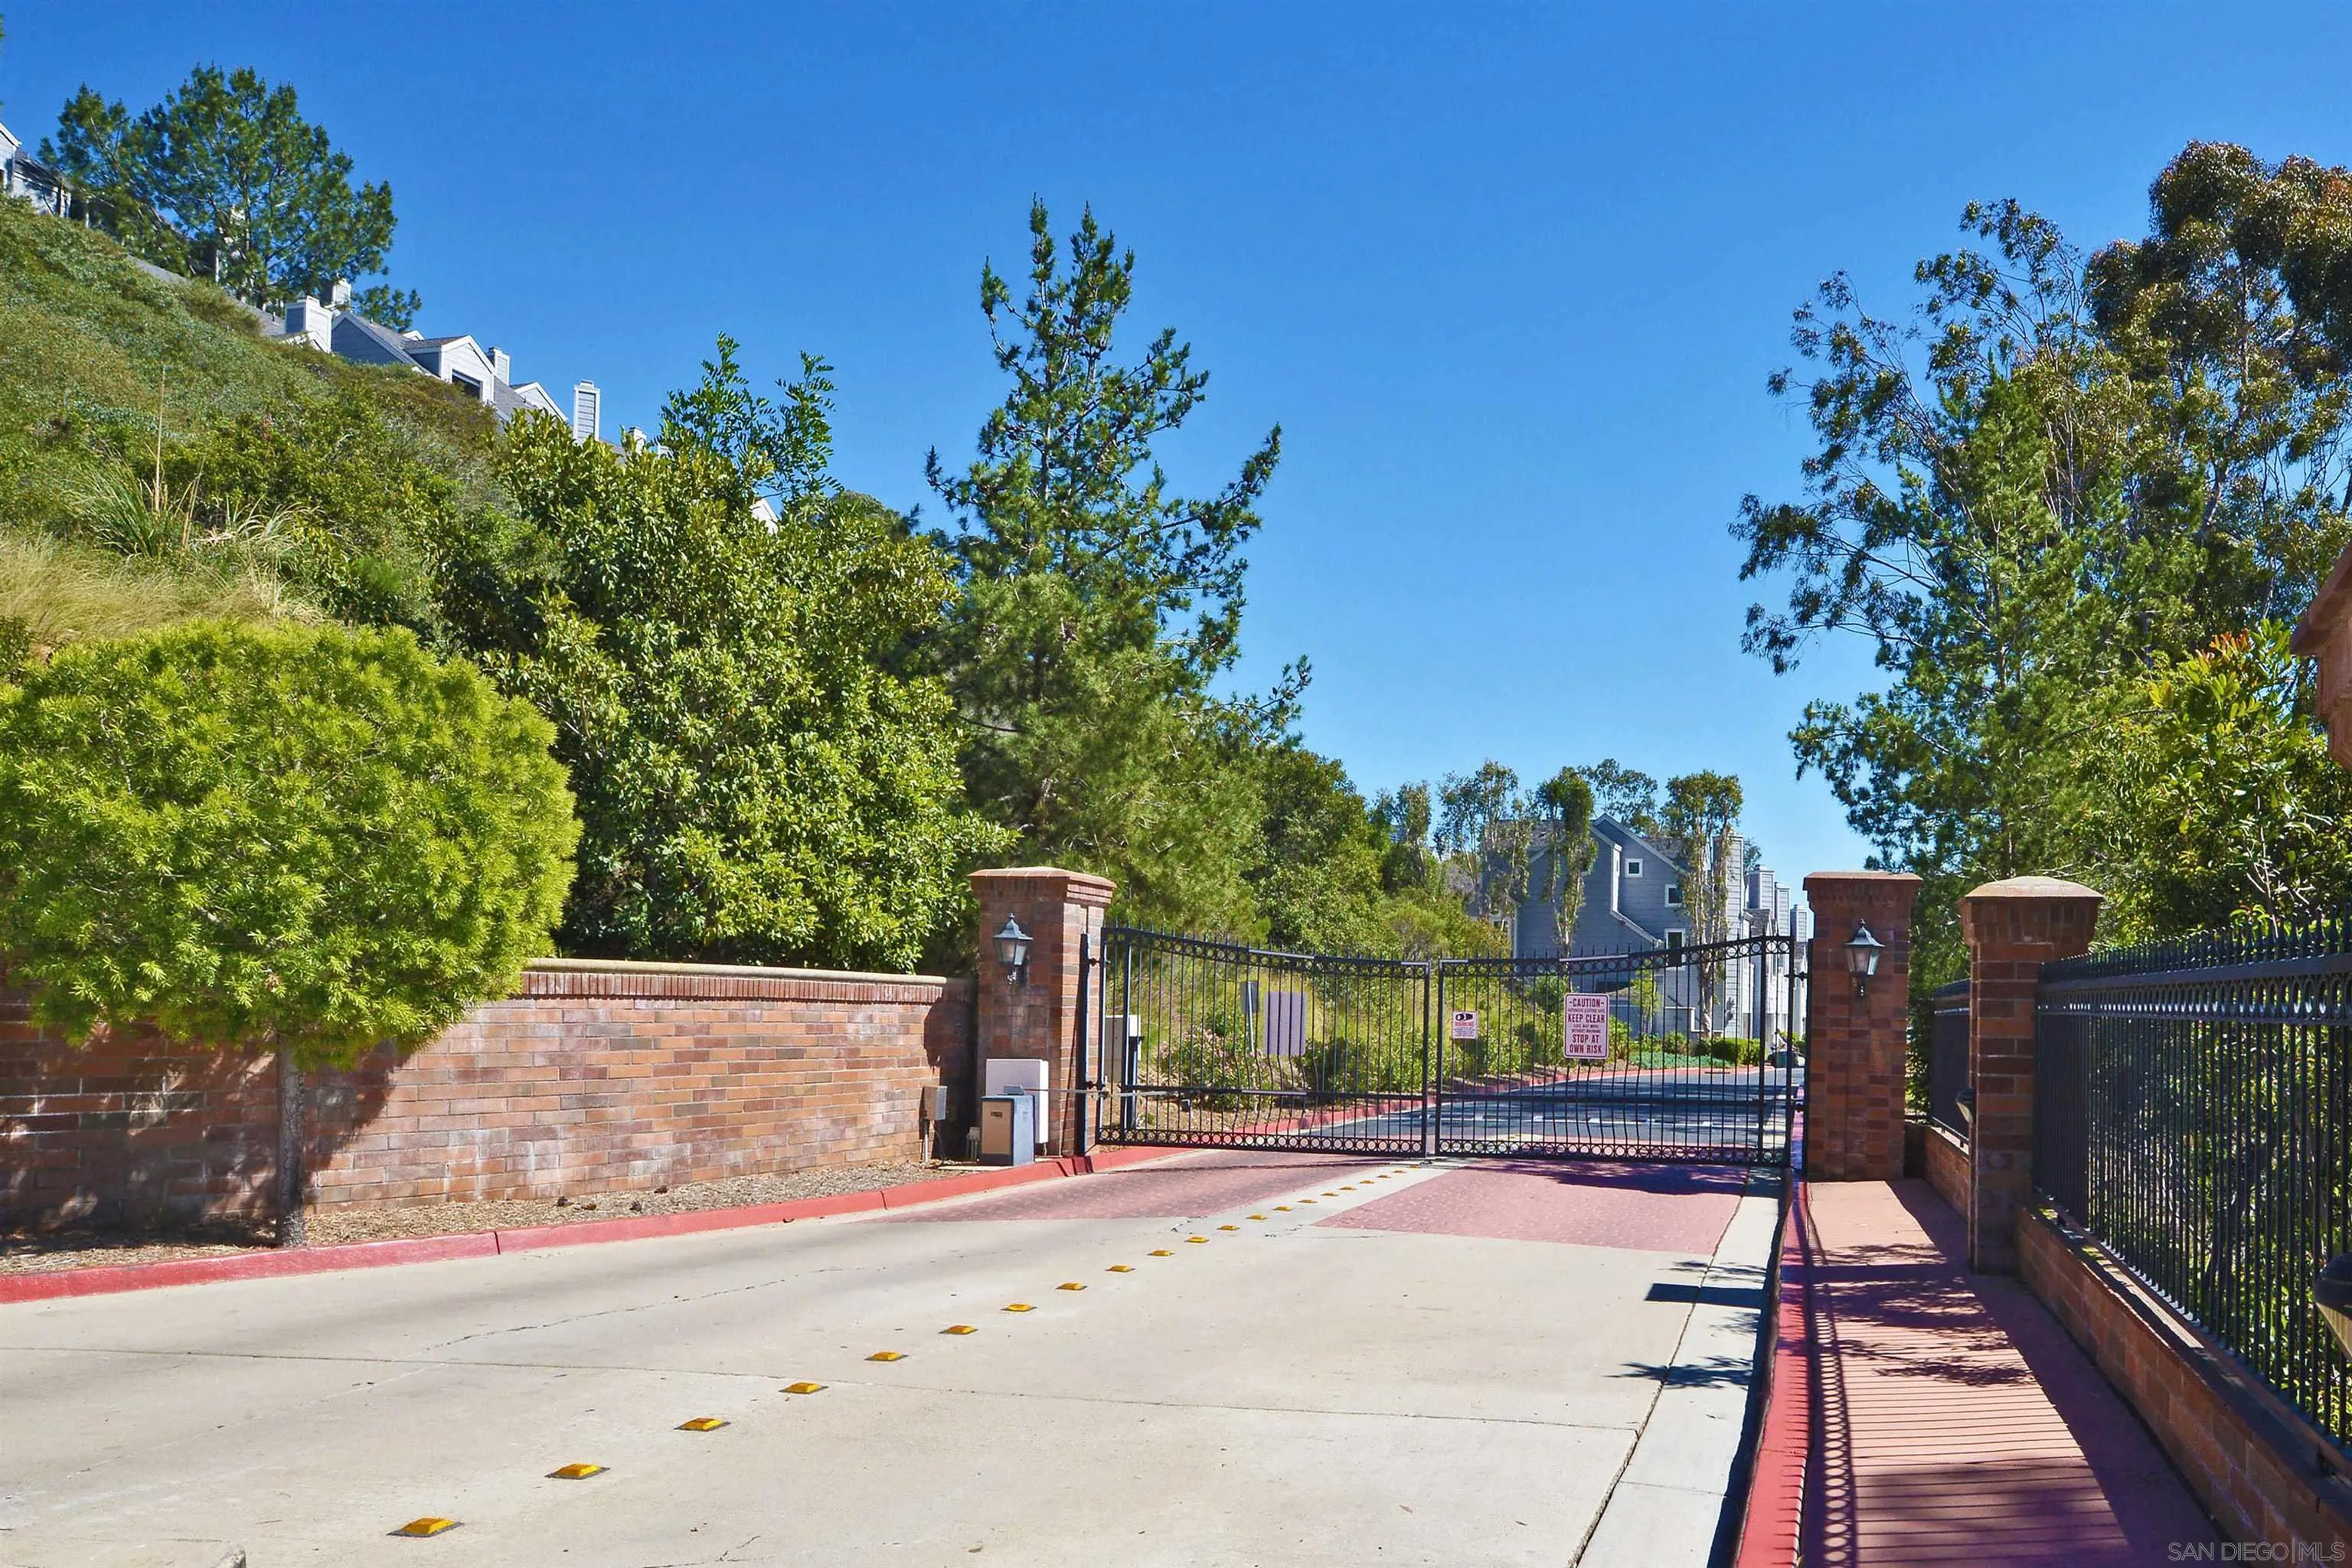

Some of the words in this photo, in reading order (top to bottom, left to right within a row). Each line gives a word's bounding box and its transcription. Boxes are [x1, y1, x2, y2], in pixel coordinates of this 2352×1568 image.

[1568, 1014, 1583, 1023] KEEP
[1586, 1014, 1605, 1024] CLEAR
[1573, 1034, 1589, 1043] STOP
[1592, 1034, 1599, 1044] AT
[1570, 1044, 1584, 1054] OWN
[1587, 1044, 1602, 1054] RISK
